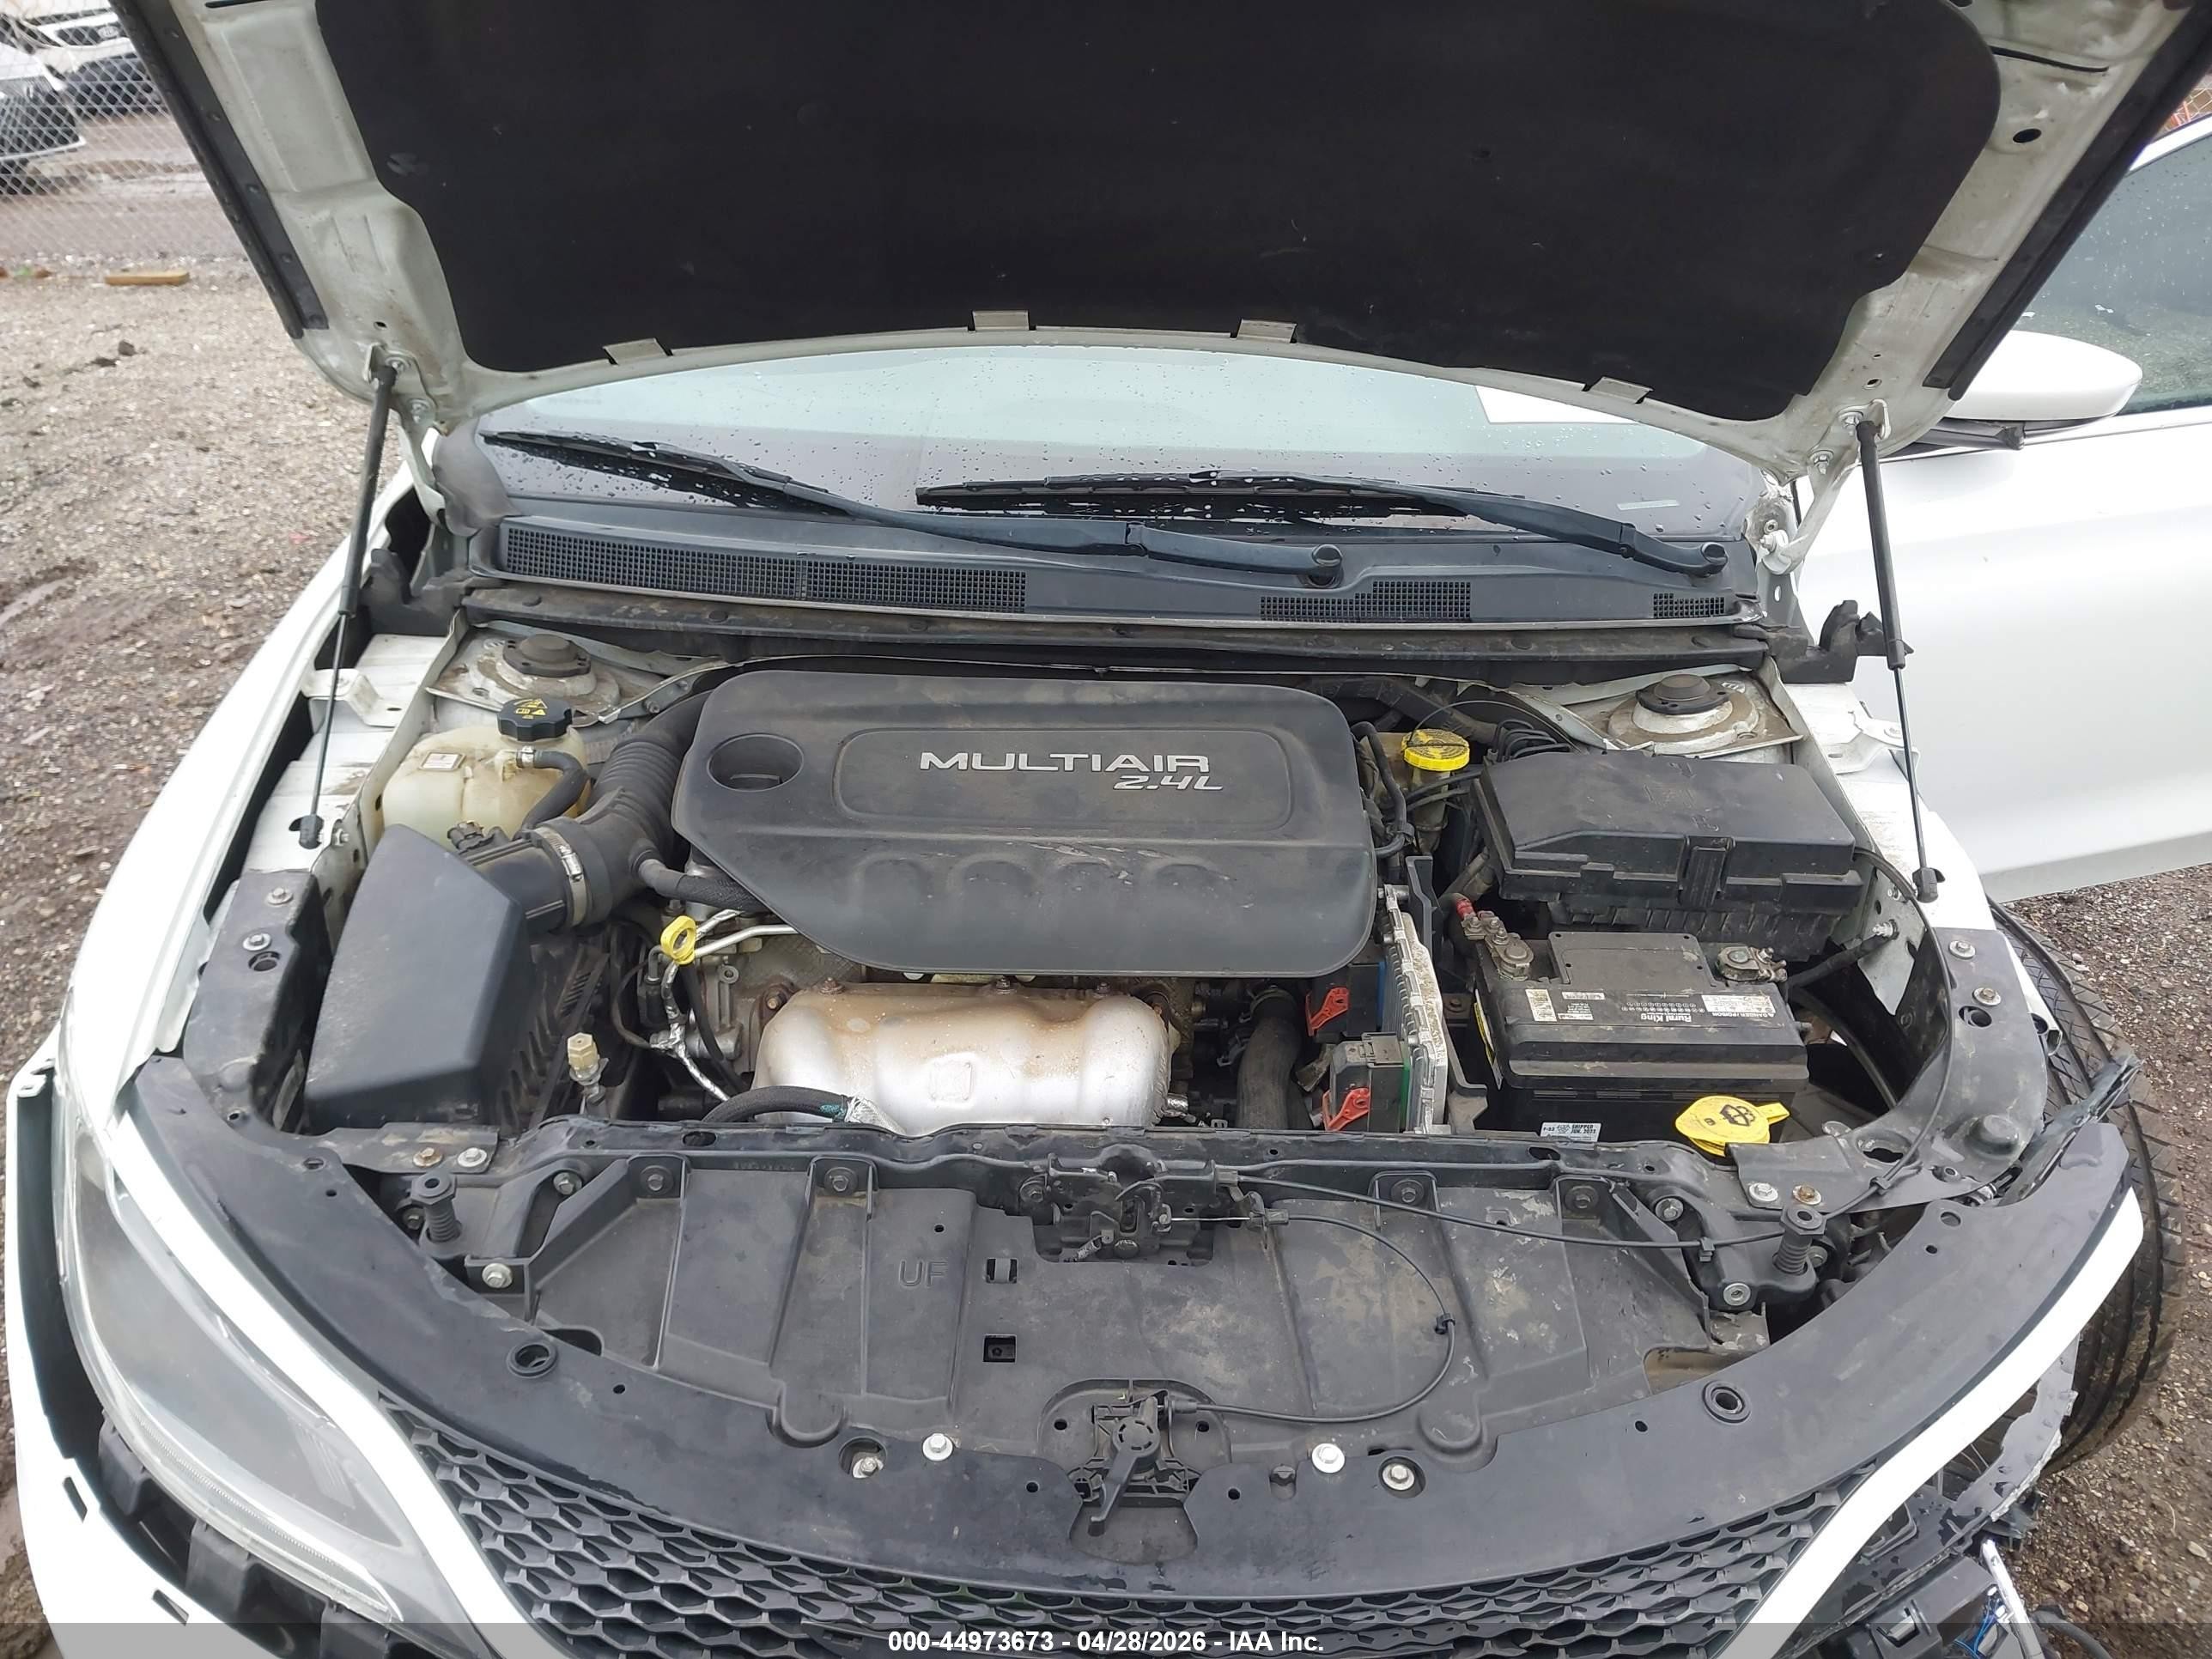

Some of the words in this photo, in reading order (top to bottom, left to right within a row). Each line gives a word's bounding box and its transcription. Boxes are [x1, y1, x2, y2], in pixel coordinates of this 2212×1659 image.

[920, 752, 1210, 772] MULTIAIR
[1113, 775, 1223, 791] 2.4L
[1640, 1012, 1663, 1023] King
[1665, 1013, 1692, 1023] Rural
[899, 1260, 948, 1289] UF
